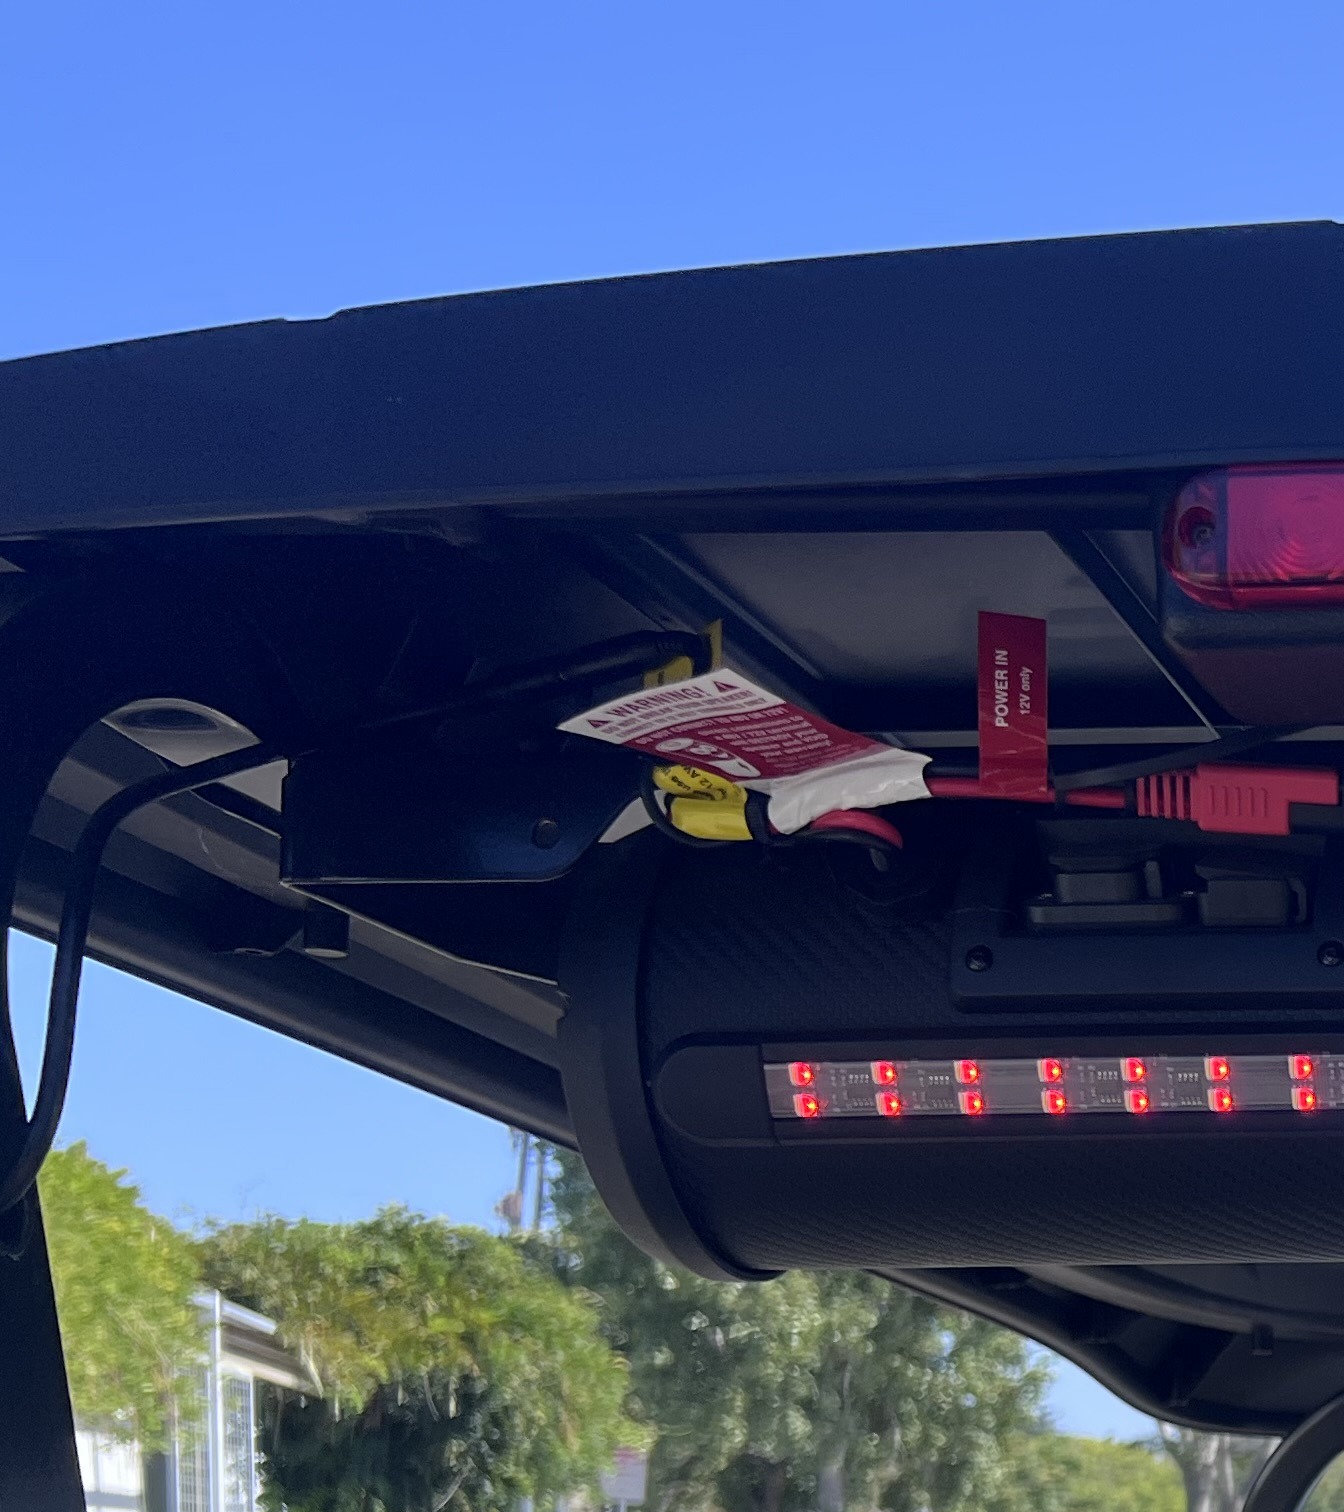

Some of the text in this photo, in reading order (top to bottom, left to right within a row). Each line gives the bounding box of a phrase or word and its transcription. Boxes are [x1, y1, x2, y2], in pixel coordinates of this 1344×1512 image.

[606, 686, 713, 717] WARNING!
[994, 649, 1009, 727] POWER IN
[1019, 666, 1033, 715] 12V only
